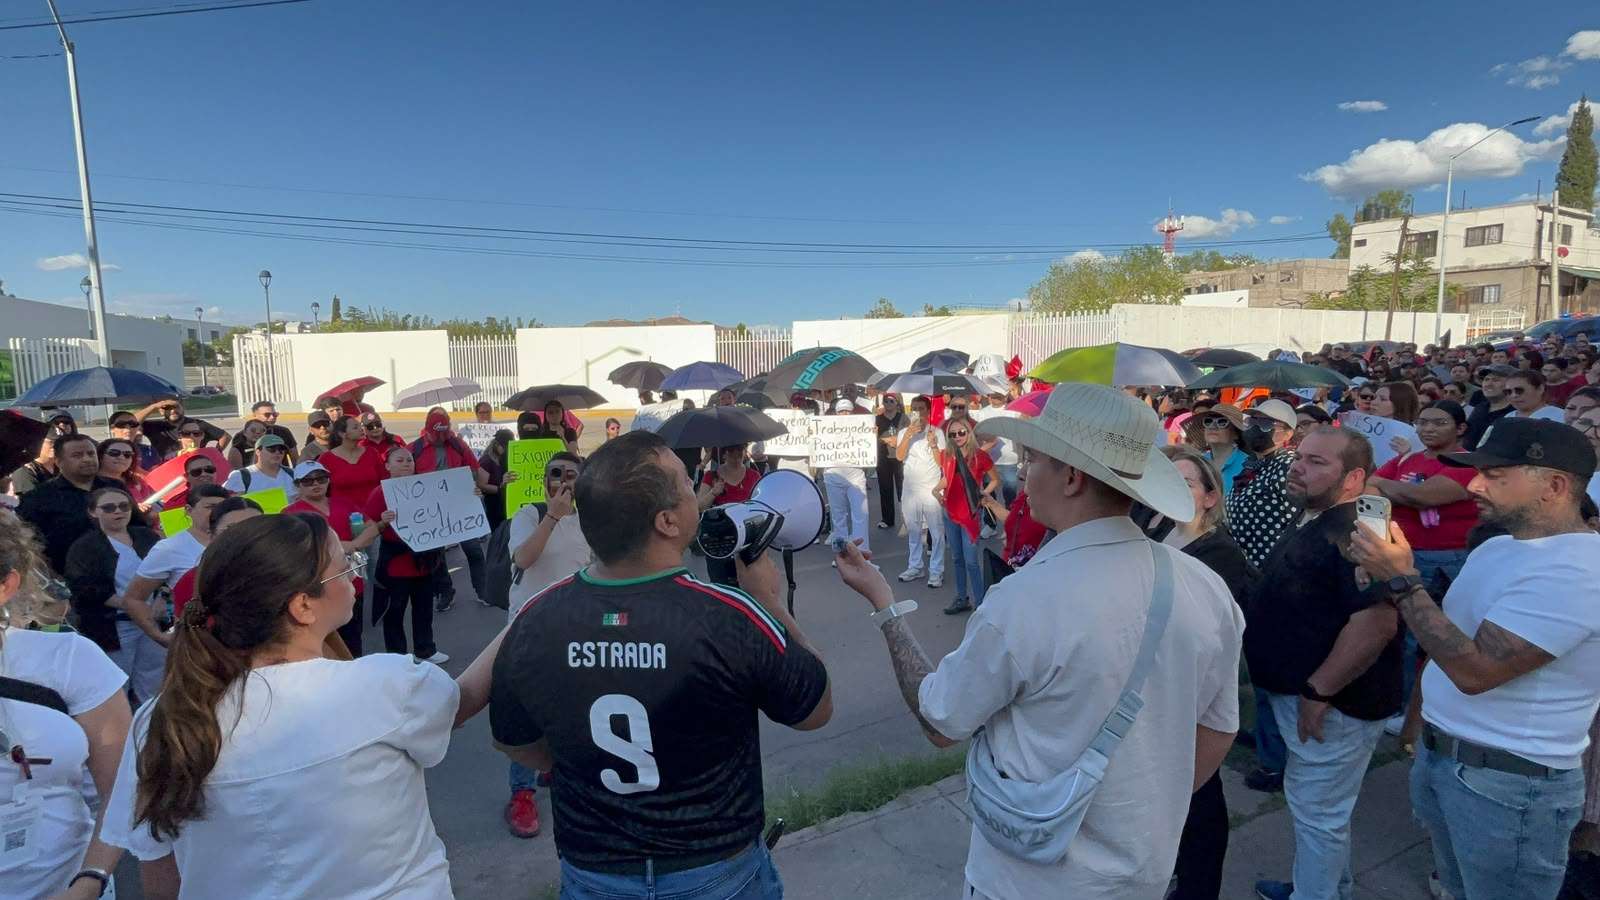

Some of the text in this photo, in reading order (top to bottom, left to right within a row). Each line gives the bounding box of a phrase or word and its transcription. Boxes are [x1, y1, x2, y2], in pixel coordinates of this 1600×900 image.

[395, 502, 444, 530] Ley
[568, 641, 667, 669] ESTRADA
[589, 693, 660, 795] 9
